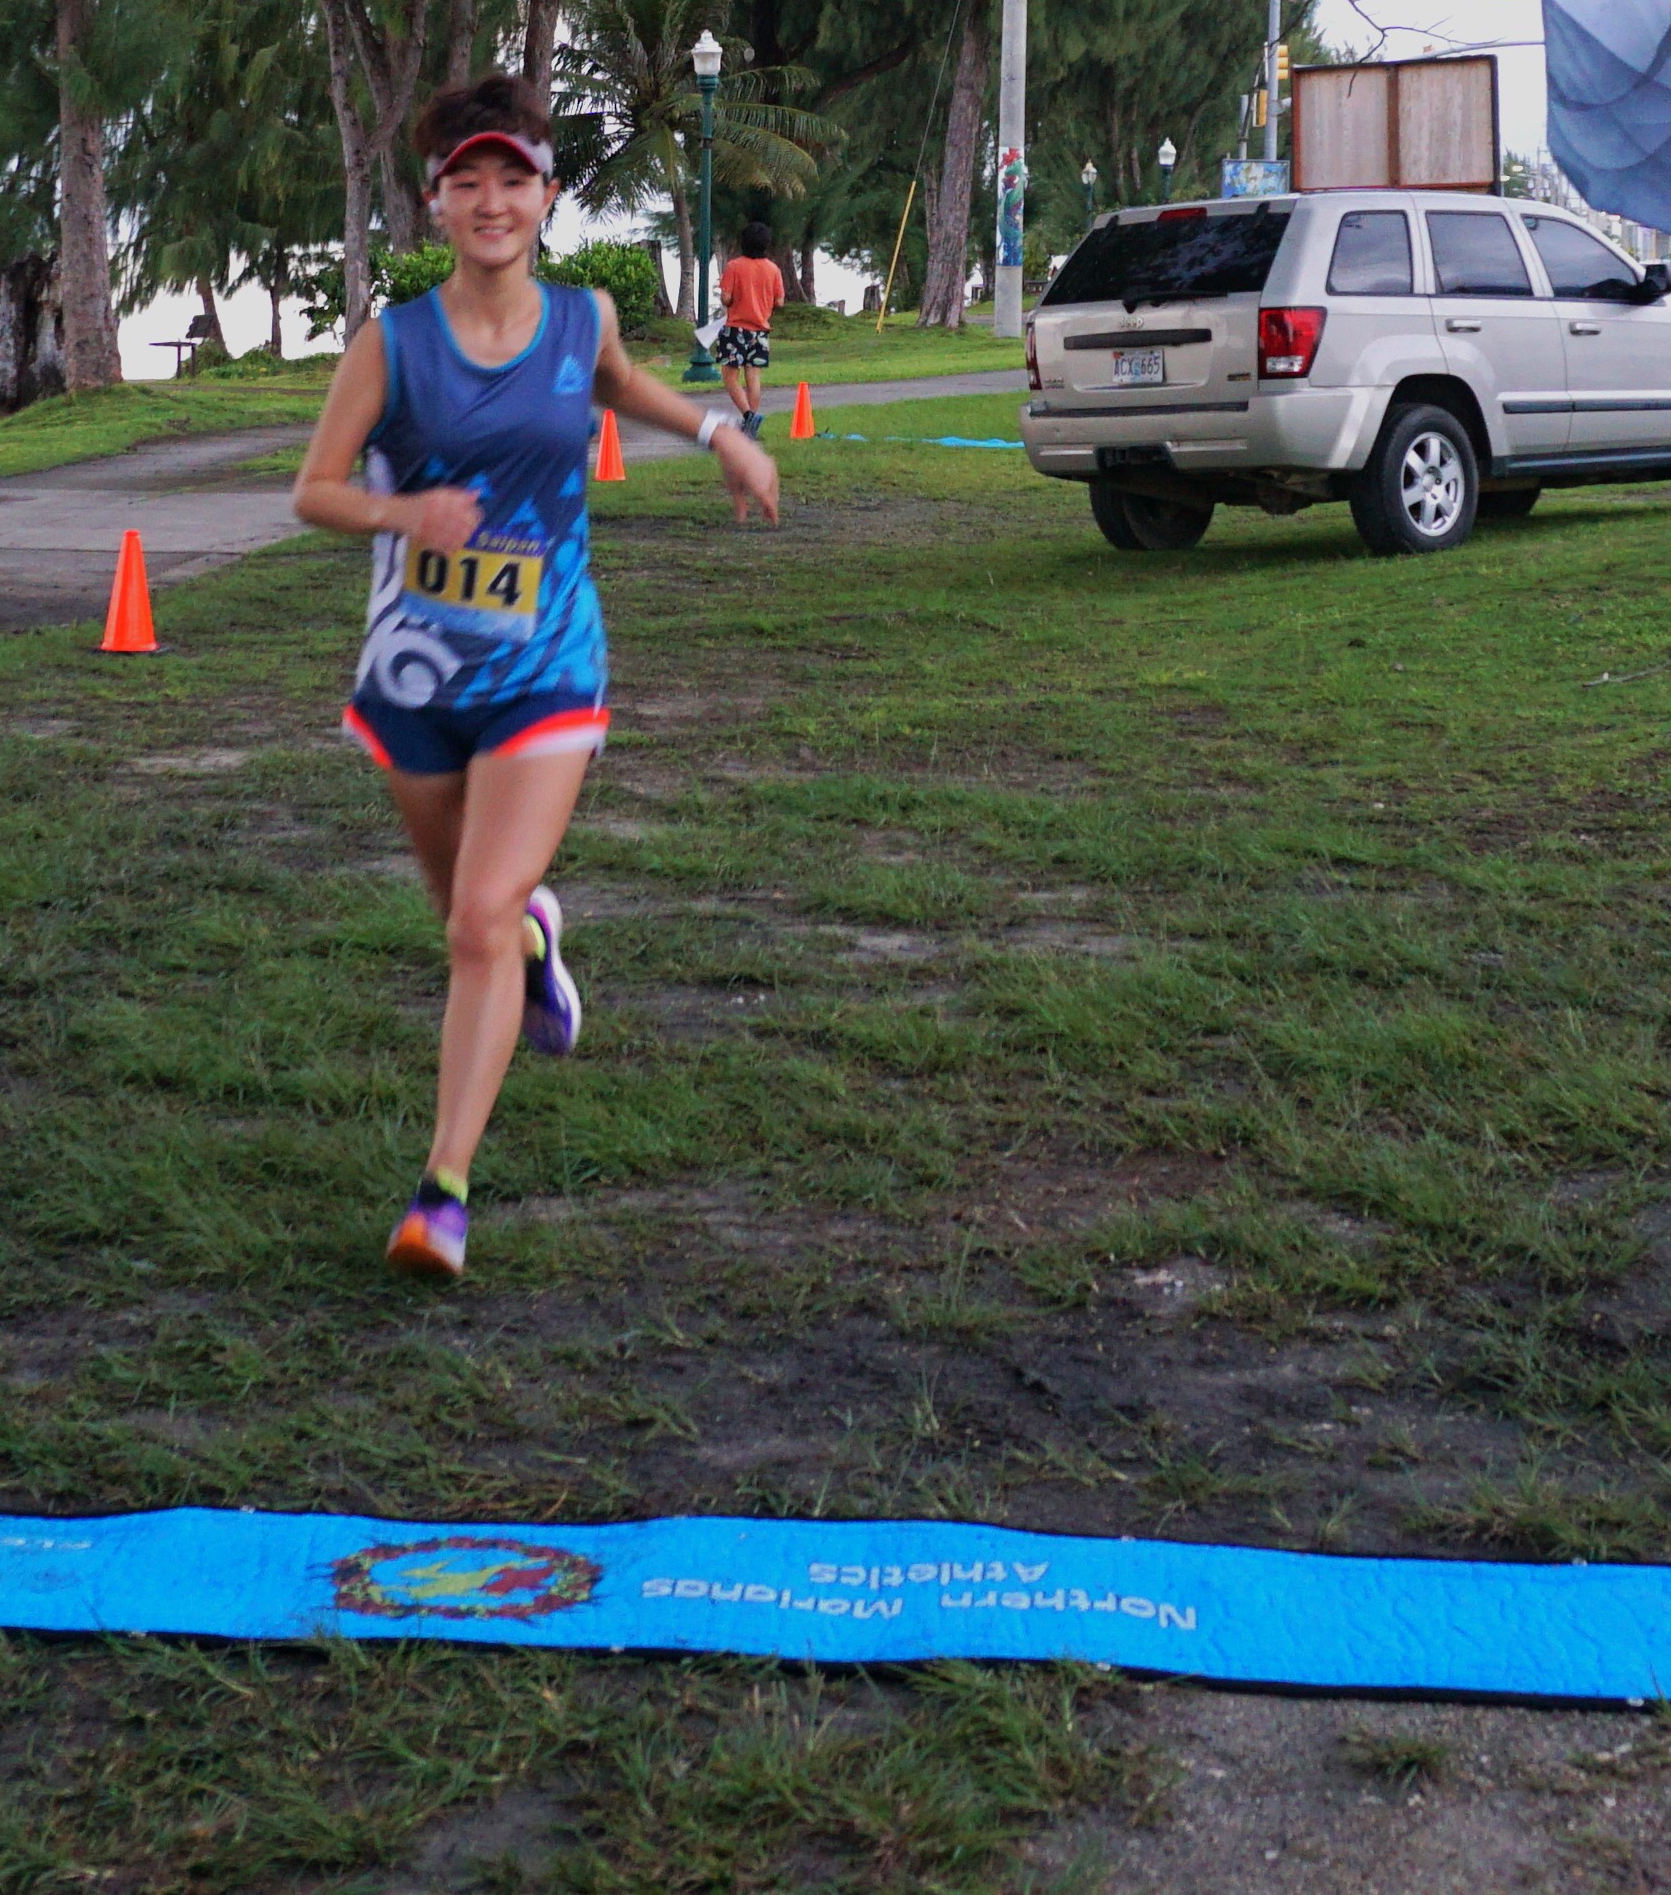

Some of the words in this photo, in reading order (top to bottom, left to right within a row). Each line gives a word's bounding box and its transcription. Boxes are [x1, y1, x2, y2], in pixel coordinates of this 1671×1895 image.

[417, 548, 522, 607] 014
[808, 1560, 1051, 1589] Athletics
[641, 1576, 903, 1620] Marianas
[940, 1590, 1198, 1631] Northern
